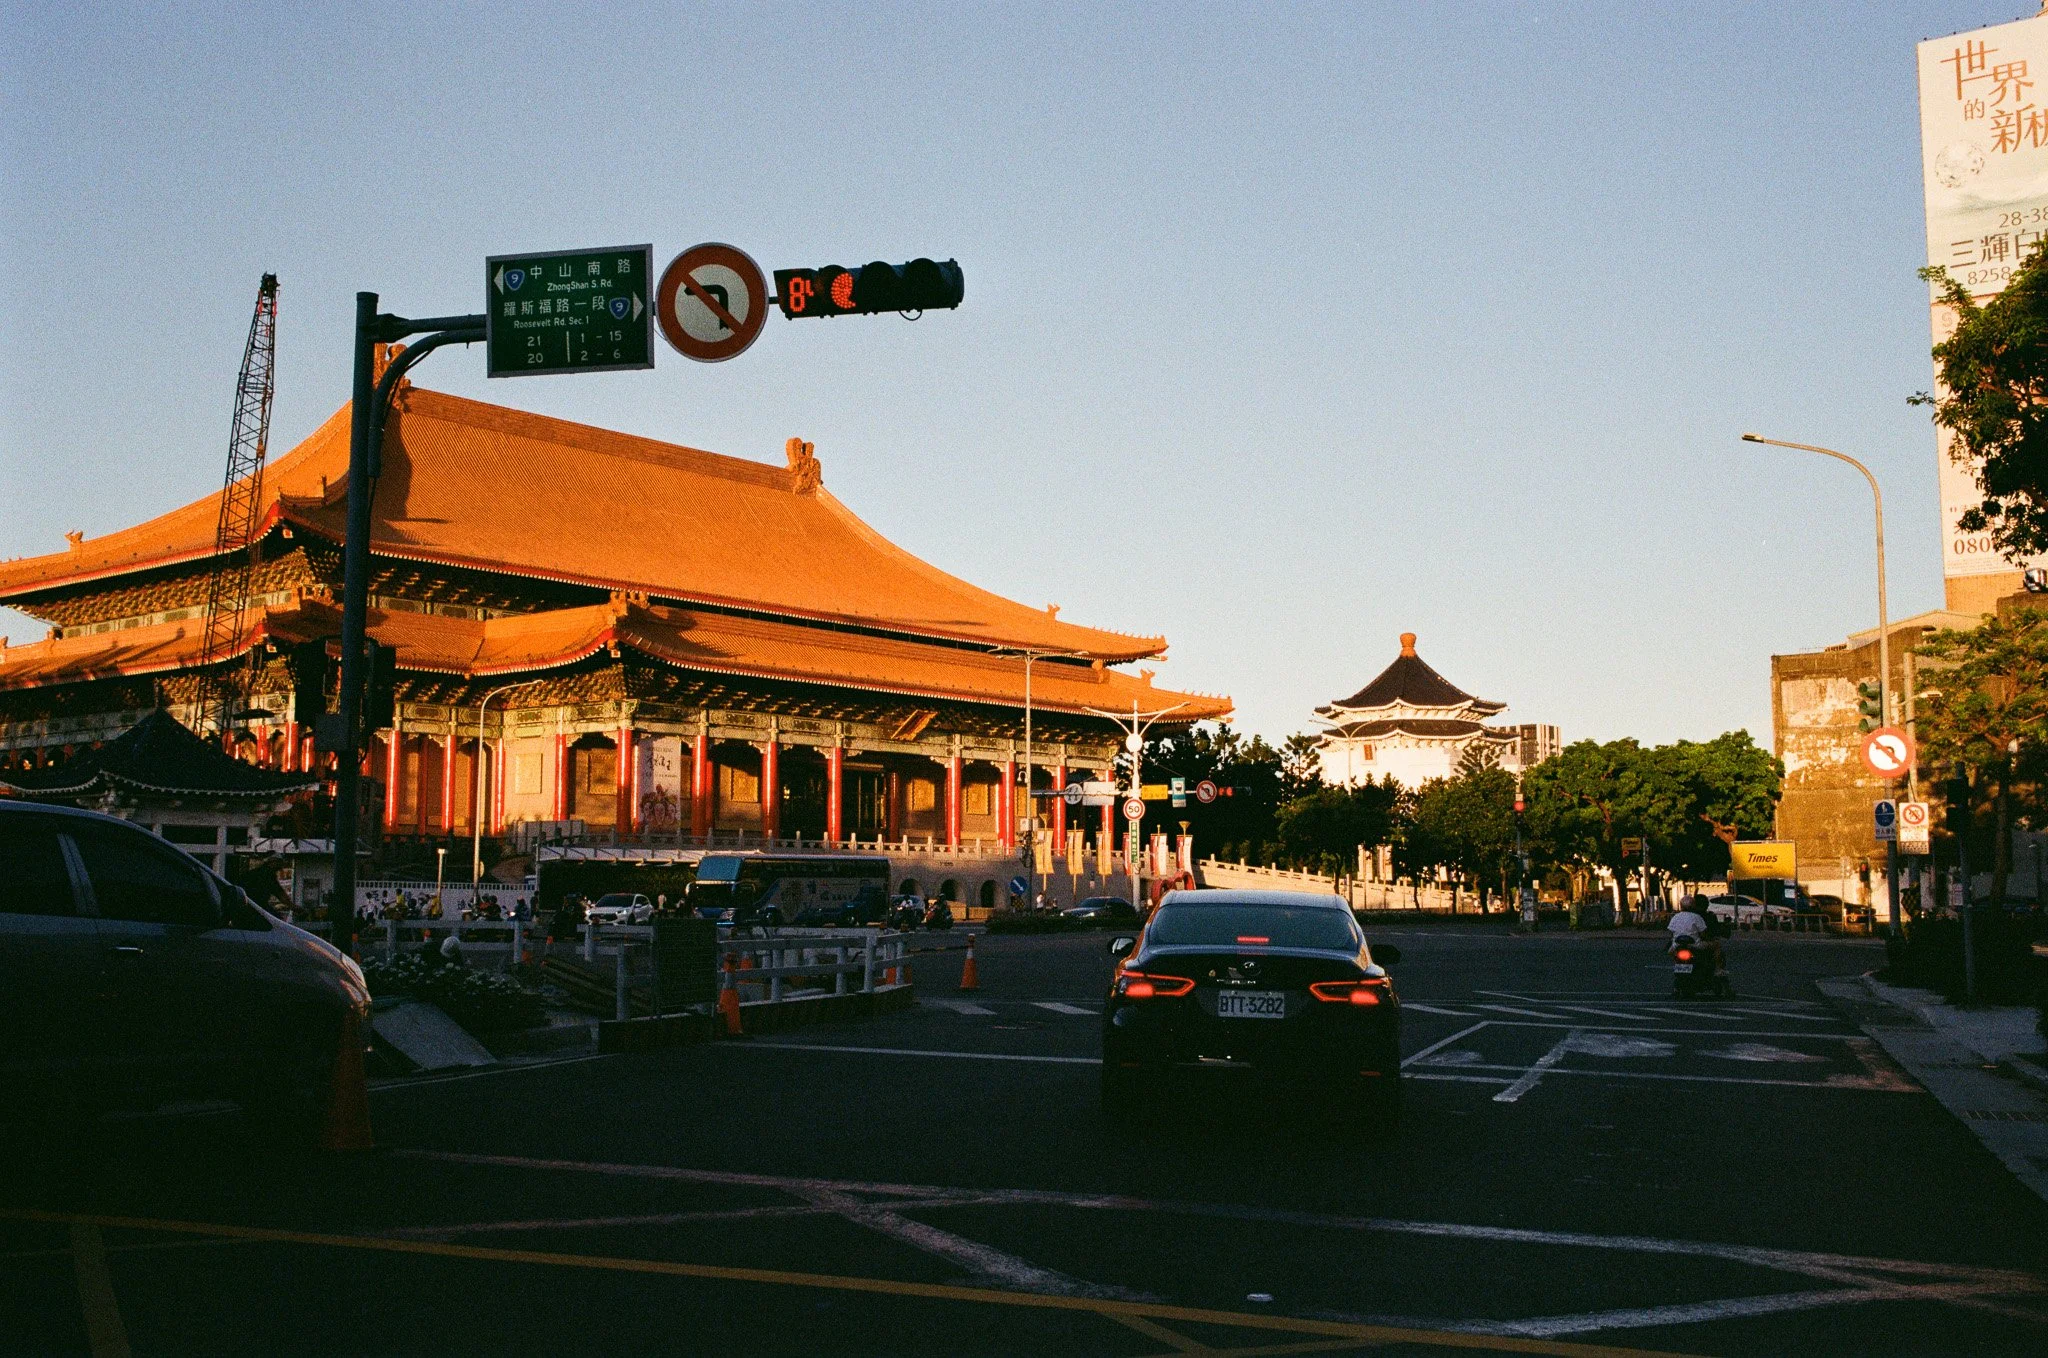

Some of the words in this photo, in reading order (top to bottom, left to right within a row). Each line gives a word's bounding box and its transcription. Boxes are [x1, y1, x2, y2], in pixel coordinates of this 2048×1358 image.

[530, 258, 631, 279] 中山南路
[511, 274, 519, 284] 9
[547, 282, 589, 292] ZhongShan
[601, 279, 613, 288] Rd.
[504, 296, 605, 317] 羅斯福路一段
[616, 302, 624, 312] 9
[514, 318, 551, 329] Roosevelt
[554, 317, 567, 326] Rd.
[569, 317, 584, 325] Sec.
[527, 336, 541, 347] 21
[609, 330, 622, 342] 15
[528, 353, 543, 364] 20
[581, 350, 588, 361] 2
[613, 349, 621, 359] 6
[1128, 805, 1140, 813] 50
[1748, 853, 1779, 863] Times
